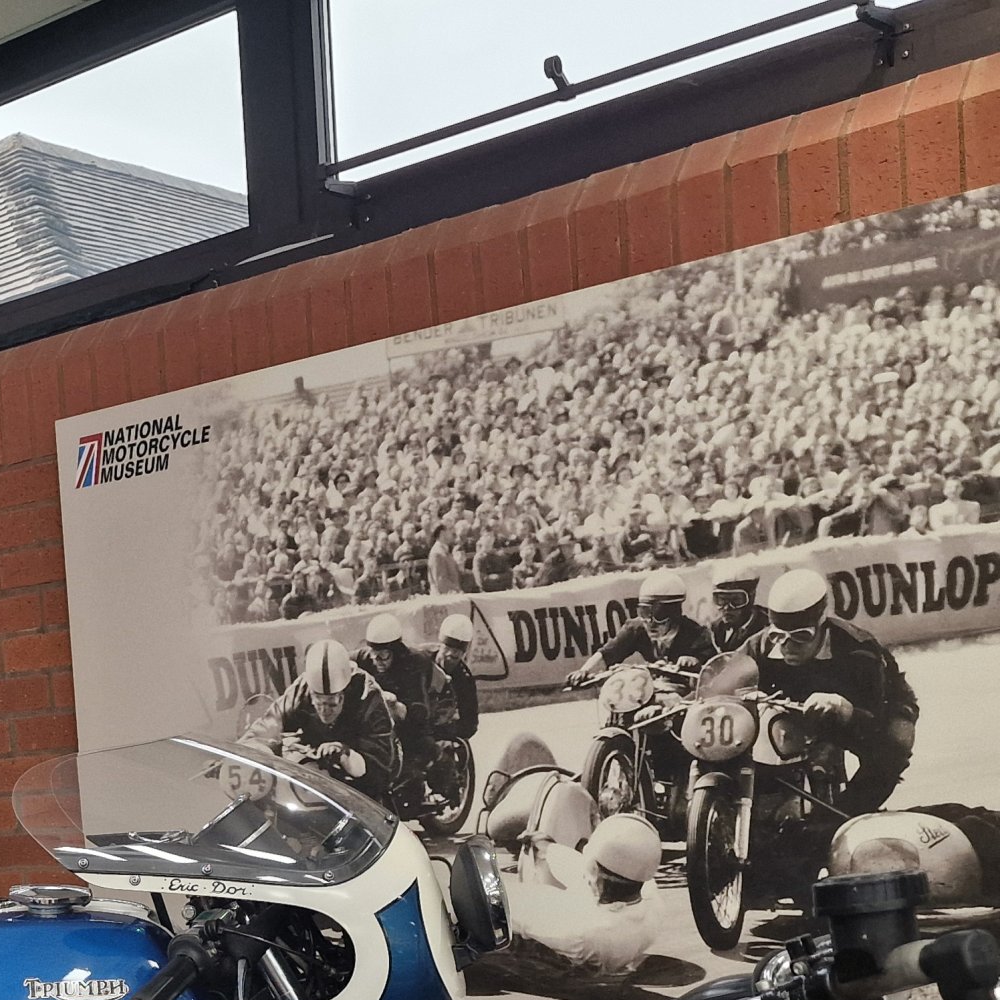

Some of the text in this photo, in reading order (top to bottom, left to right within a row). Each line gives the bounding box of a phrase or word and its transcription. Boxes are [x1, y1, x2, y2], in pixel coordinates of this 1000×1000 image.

[102, 425, 211, 466] MOTORCYCLE
[103, 413, 183, 447] NATIONAL
[100, 453, 169, 484] MUSEUM
[826, 551, 1000, 621] DUNLOP
[208, 644, 314, 712] DUNL
[700, 714, 735, 748] 30
[227, 764, 266, 792] 54
